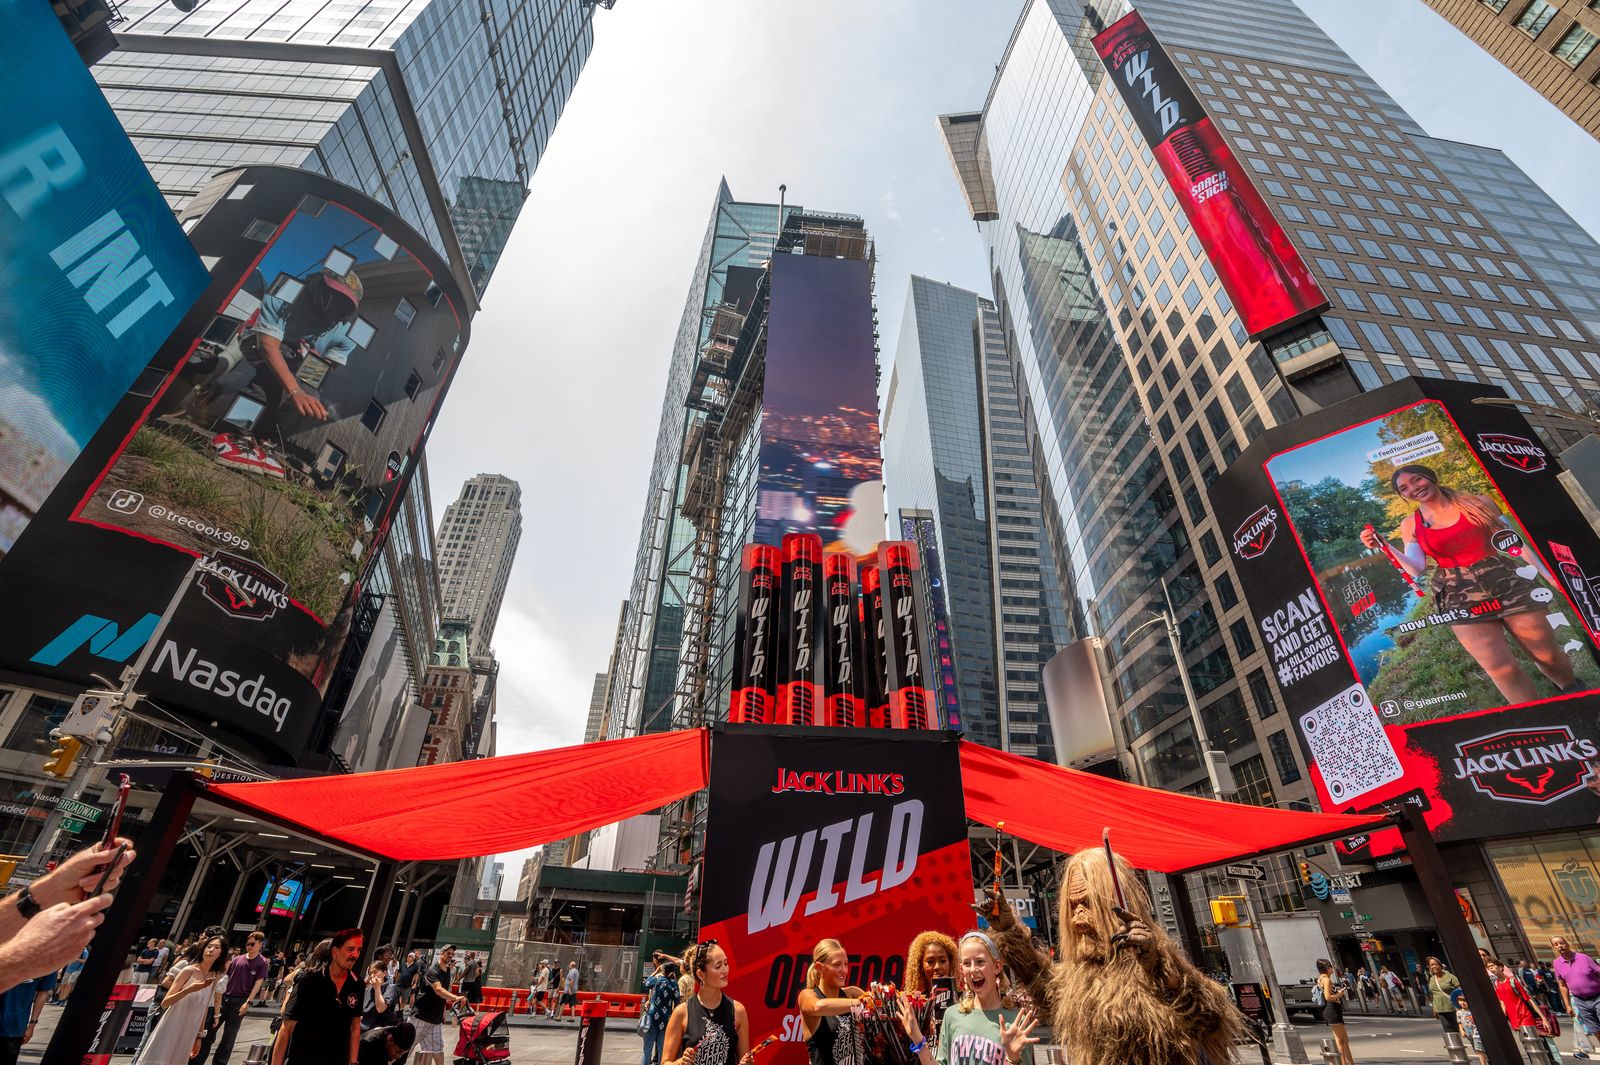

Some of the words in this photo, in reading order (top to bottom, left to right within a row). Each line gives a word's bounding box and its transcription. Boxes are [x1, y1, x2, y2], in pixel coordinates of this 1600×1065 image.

[1125, 50, 1180, 136] WILD
[49, 209, 175, 339] INT
[1478, 440, 1511, 454] JACK
[1507, 443, 1546, 457] LINK'S
[148, 505, 250, 550] @trecook999
[1233, 529, 1254, 554] JACK
[1251, 509, 1278, 537] LINK'S
[1499, 534, 1519, 550] WILD
[199, 556, 243, 588] JACK
[242, 575, 289, 609] LINK'S
[1261, 586, 1321, 643] SCAN
[1351, 592, 1377, 616] WILD
[1399, 619, 1426, 633] now
[1428, 607, 1469, 626] that's
[1471, 598, 1502, 616] wild
[750, 598, 769, 677] WILD
[794, 590, 811, 671] WILD
[833, 605, 851, 684] WILD
[897, 596, 918, 677] WILD
[1273, 631, 1302, 663] AND
[1300, 613, 1327, 644] GET
[1293, 644, 1340, 681] FAMOUS
[151, 639, 292, 733] Nasdaq
[1403, 690, 1468, 711] @giaarmani
[1453, 751, 1520, 779] JACK
[1512, 739, 1598, 768] LINK'S
[1483, 741, 1507, 751] MEAT
[1511, 736, 1546, 747] SNACKS
[33, 792, 60, 804] Nasda
[772, 768, 835, 796] JACK
[835, 770, 905, 796] LINK'S
[58, 799, 99, 820] BROADWAY
[1348, 836, 1367, 849] TikTok
[1377, 857, 1402, 868] branded
[747, 799, 925, 934] WILD
